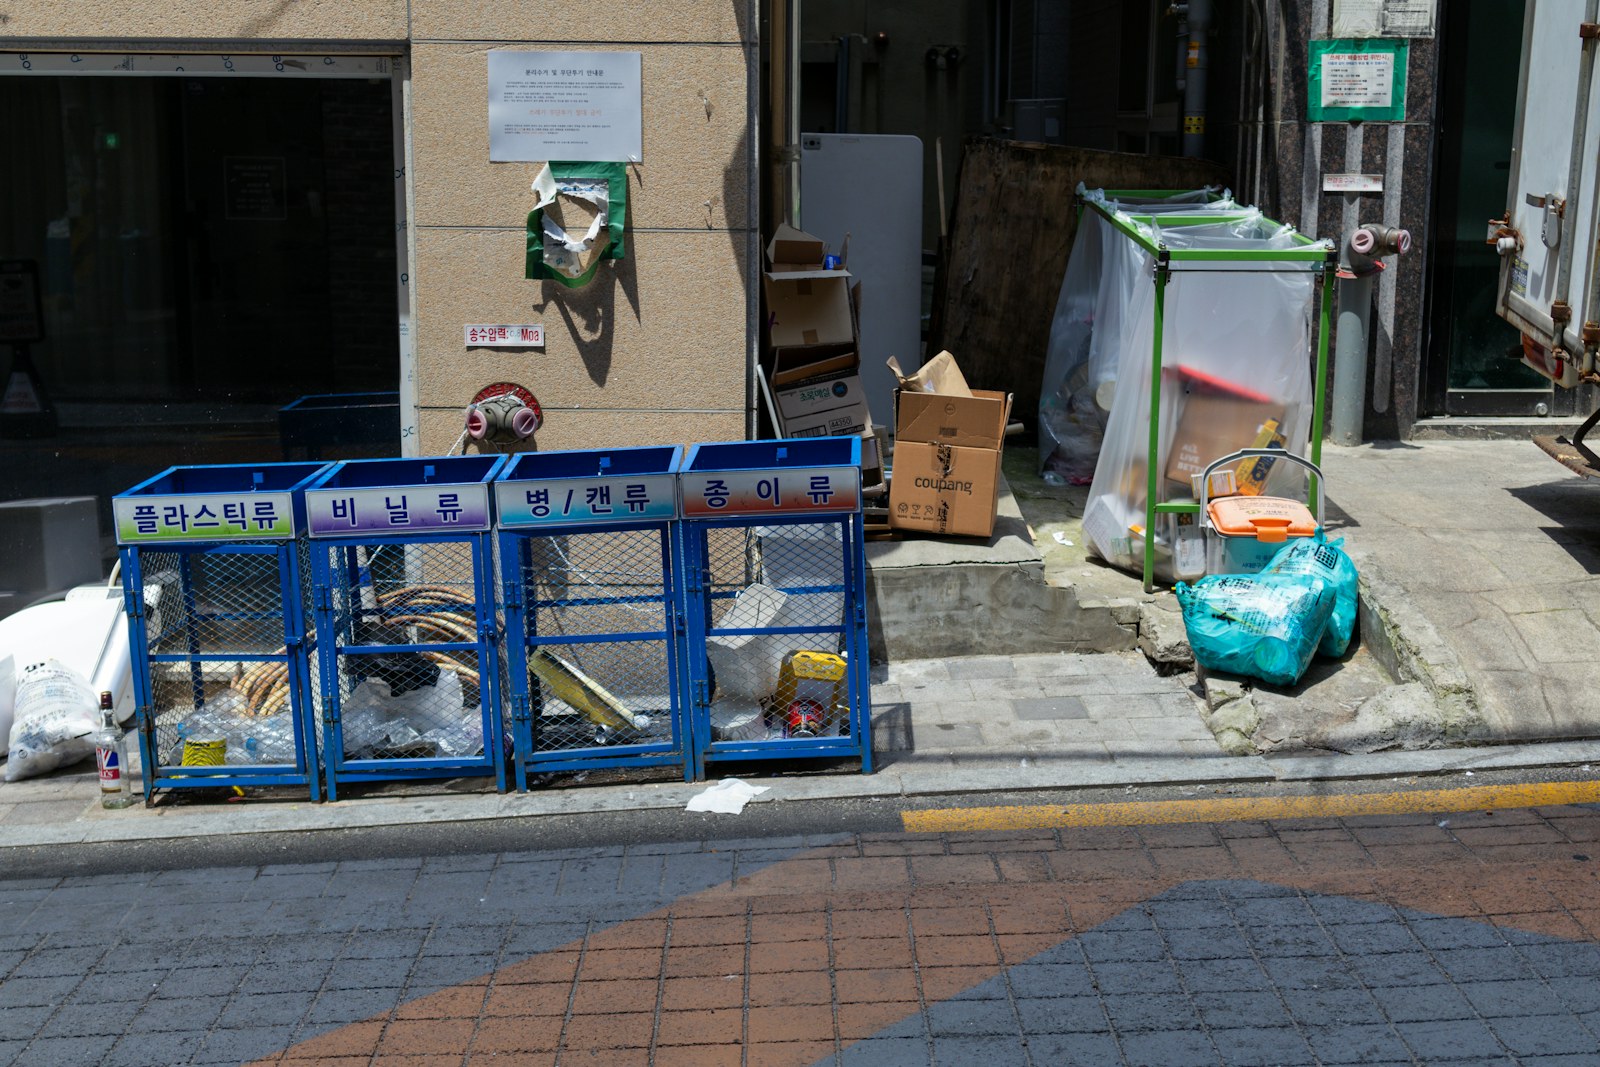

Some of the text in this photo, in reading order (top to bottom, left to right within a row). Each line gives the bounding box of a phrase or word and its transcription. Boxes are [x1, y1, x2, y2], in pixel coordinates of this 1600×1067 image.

[560, 69, 583, 77] 무단투기
[800, 388, 831, 400] 초록매실
[914, 477, 973, 496] coupang
[132, 501, 279, 534] 플라스틱류
